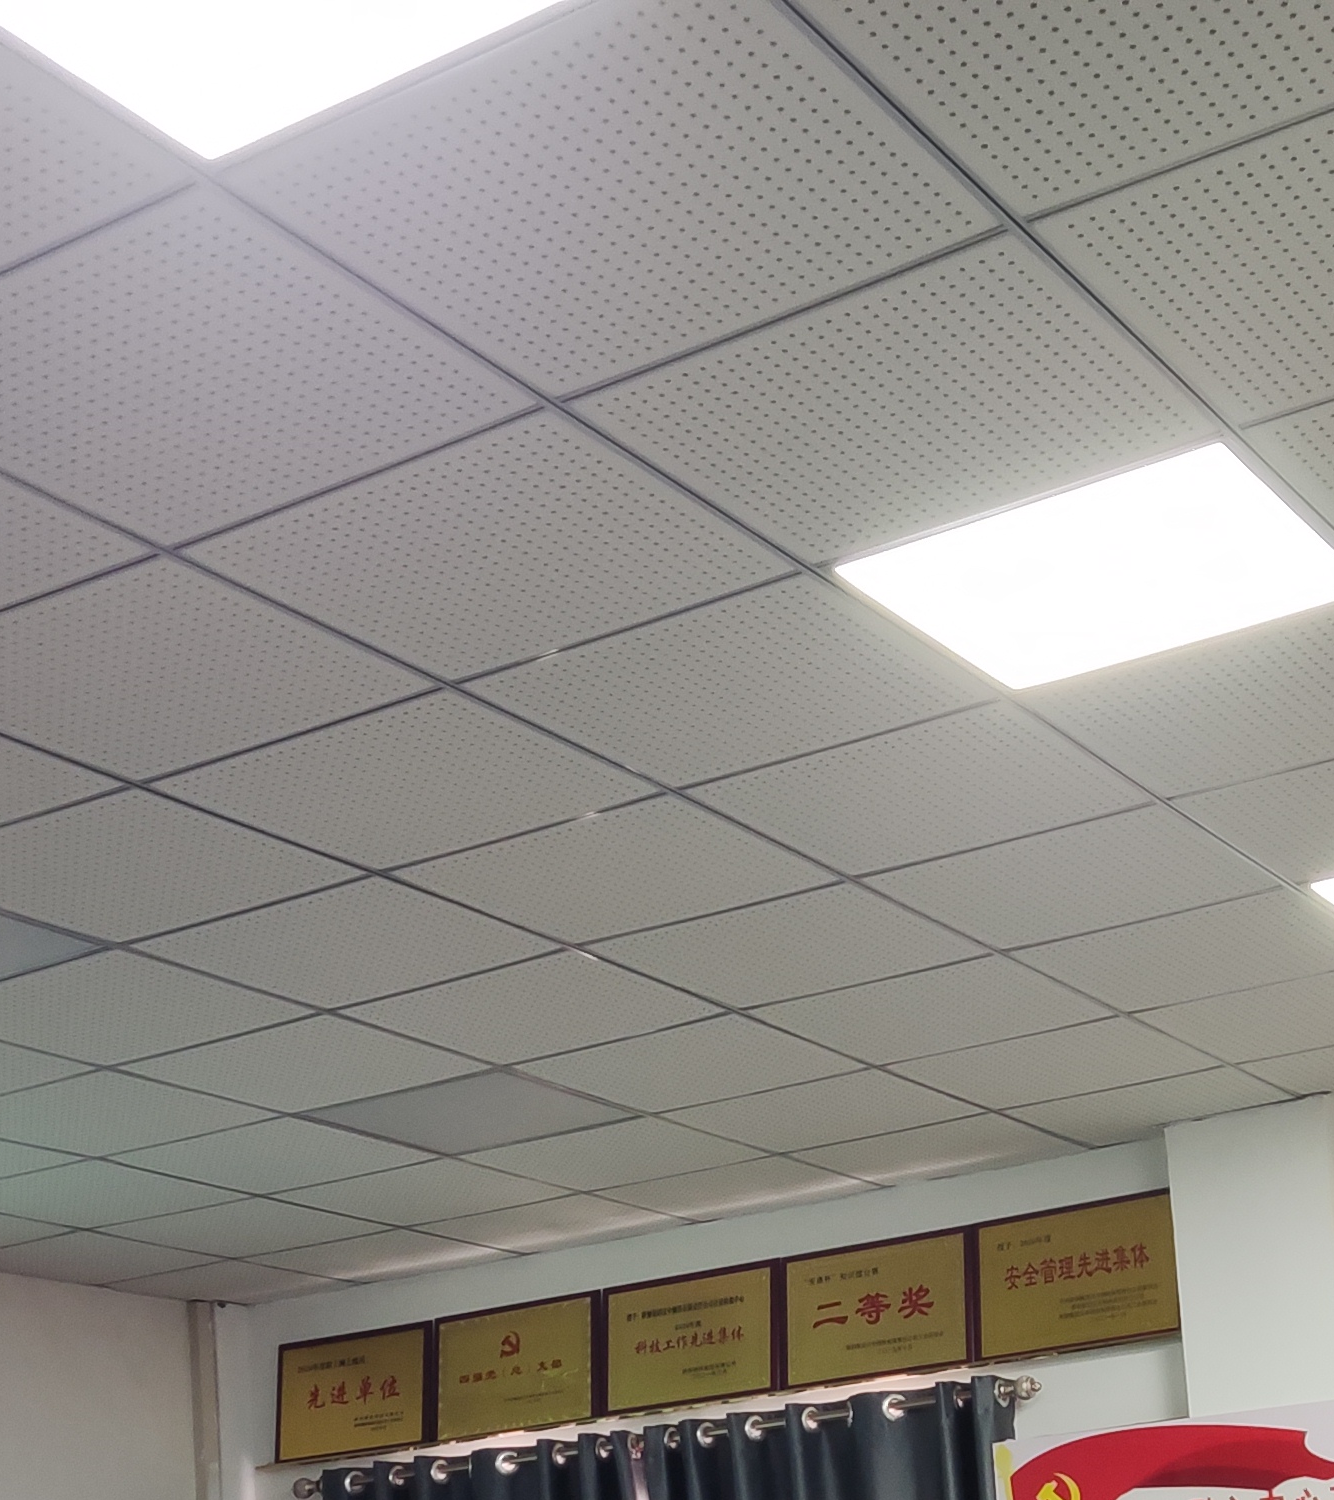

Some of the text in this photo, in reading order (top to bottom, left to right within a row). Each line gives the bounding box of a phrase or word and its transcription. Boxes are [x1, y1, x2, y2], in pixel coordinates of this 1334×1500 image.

[1005, 1243, 1149, 1291] 安全管理先进集体
[813, 1284, 935, 1329] 二等奖
[634, 1326, 744, 1354] 科技工作先进集体
[307, 1375, 400, 1410] 先进单位
